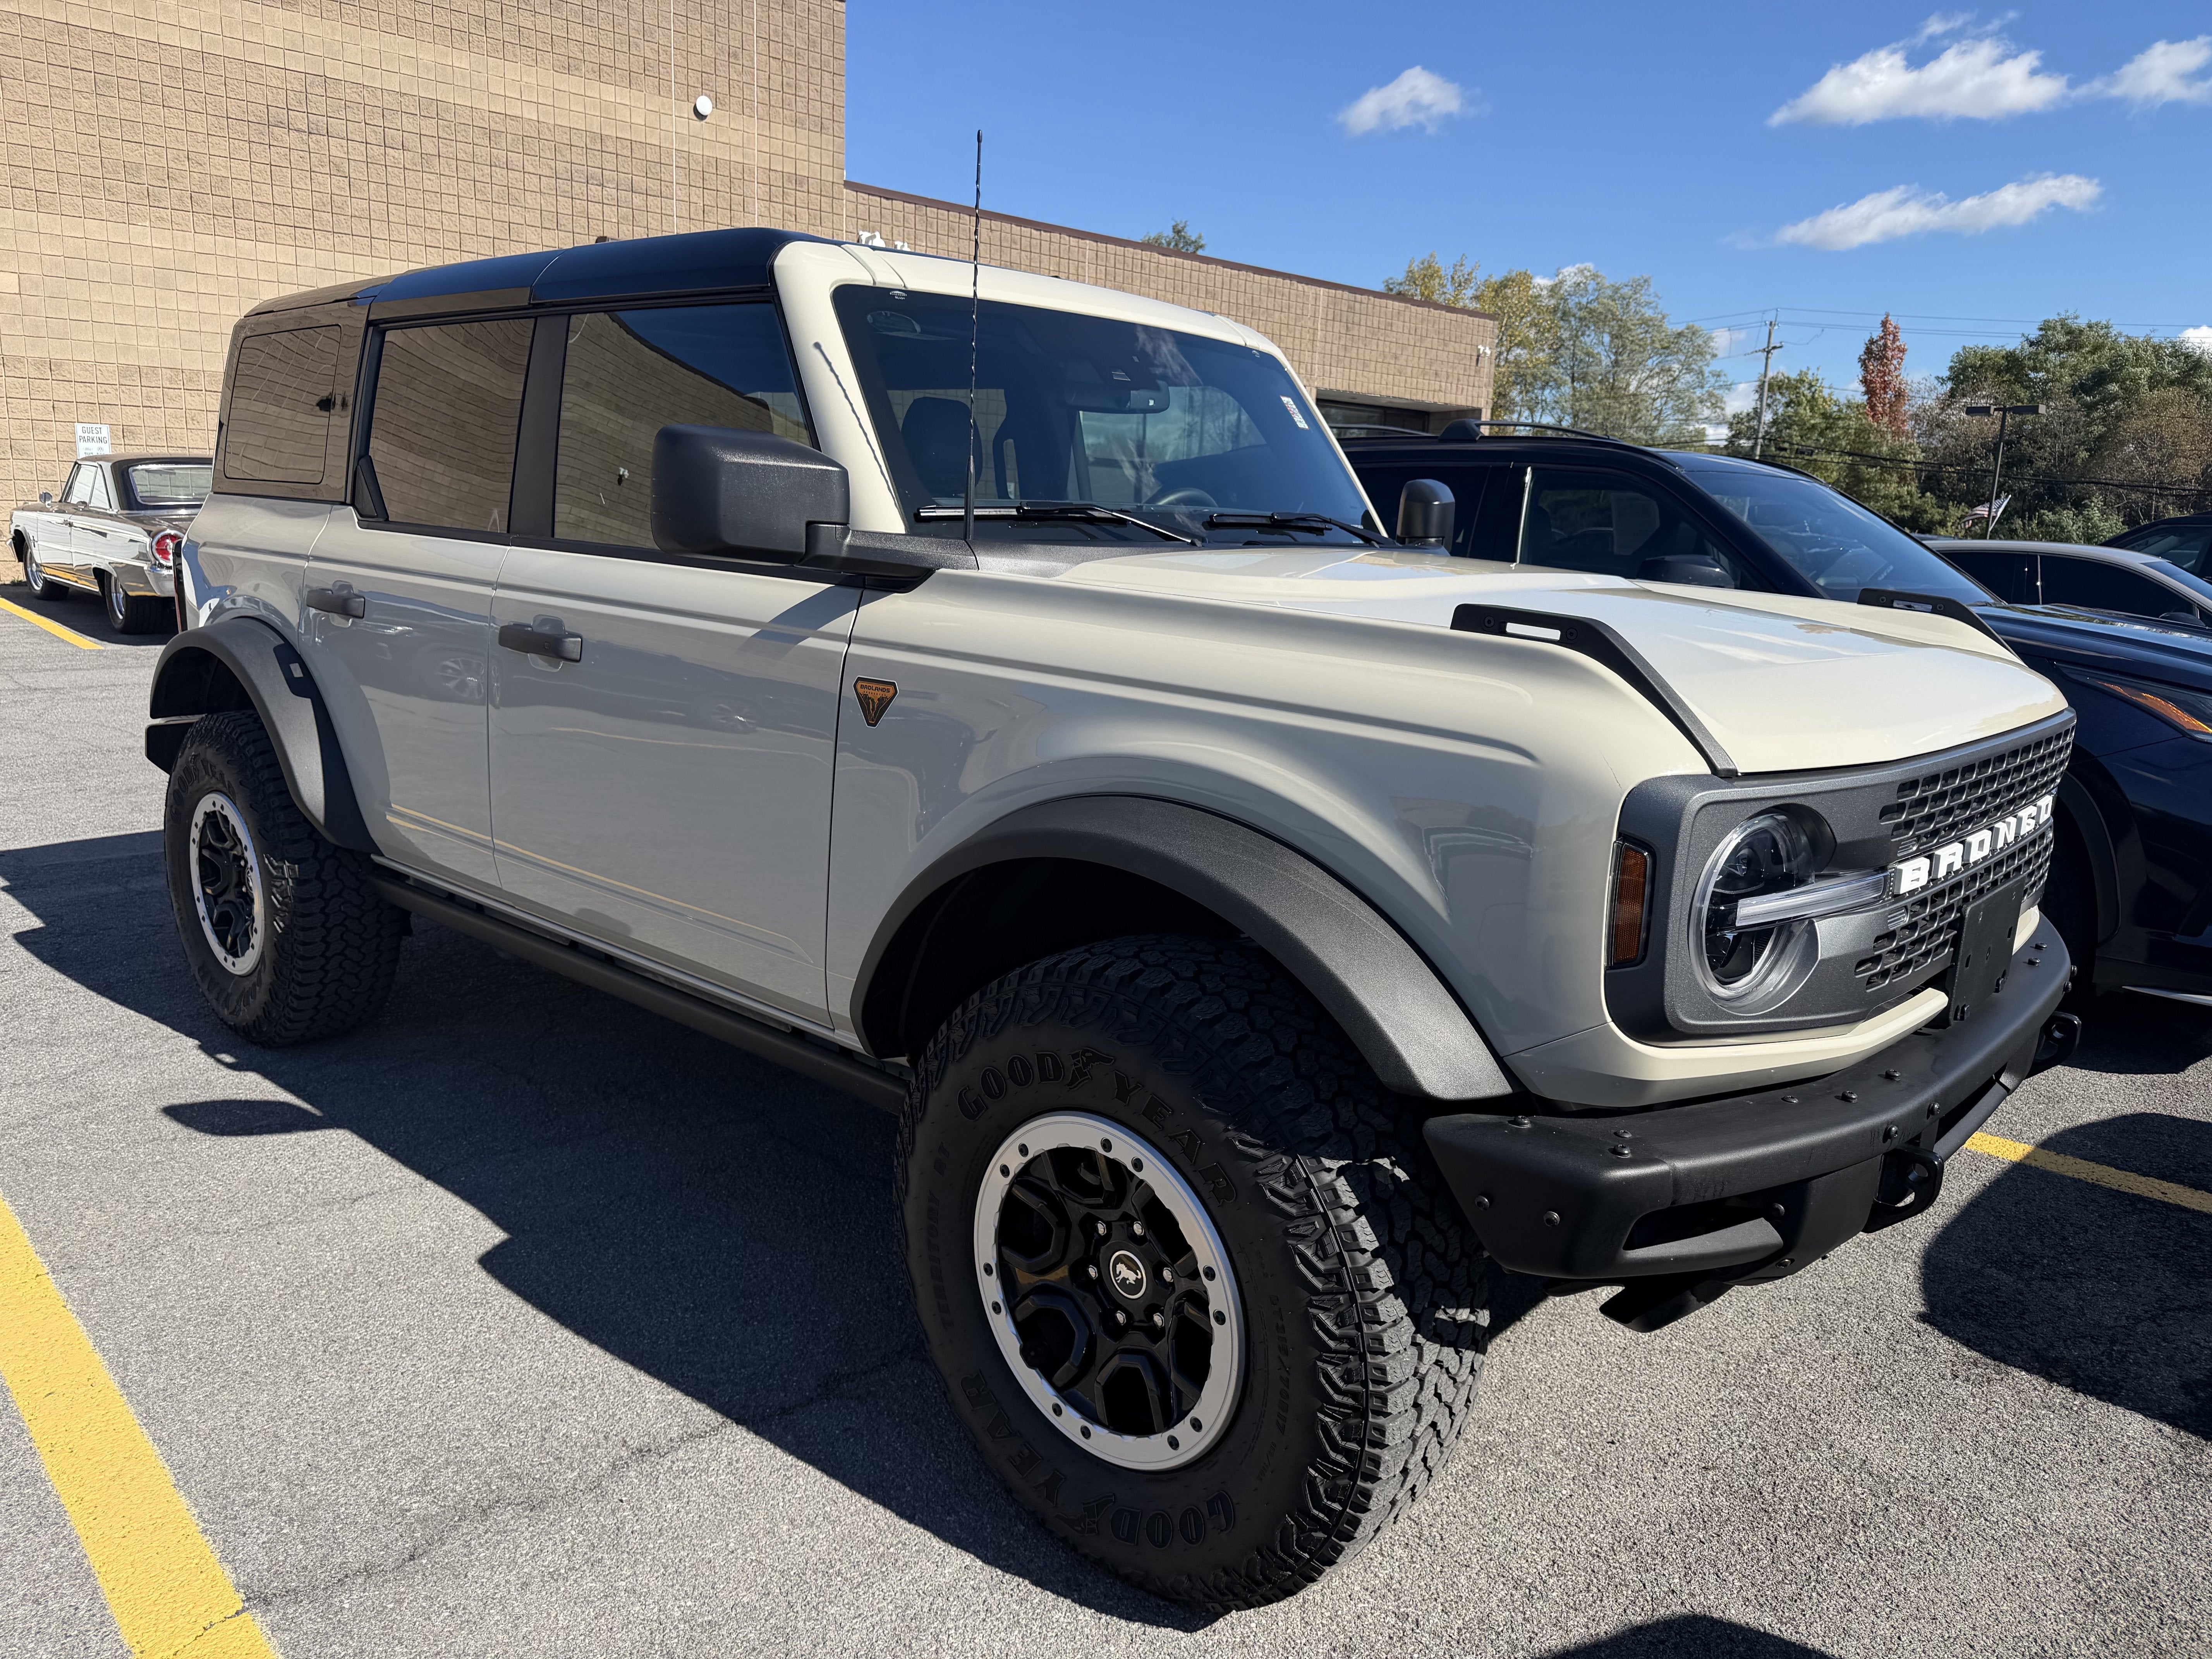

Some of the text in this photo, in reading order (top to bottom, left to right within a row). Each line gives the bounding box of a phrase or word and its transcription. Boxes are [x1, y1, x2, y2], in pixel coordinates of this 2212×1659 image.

[79, 436, 107, 444] PARKING
[860, 684, 890, 692] BADLANDS
[1894, 795, 2053, 894] BRONCO
[926, 1189, 954, 1328] TERRITORY
